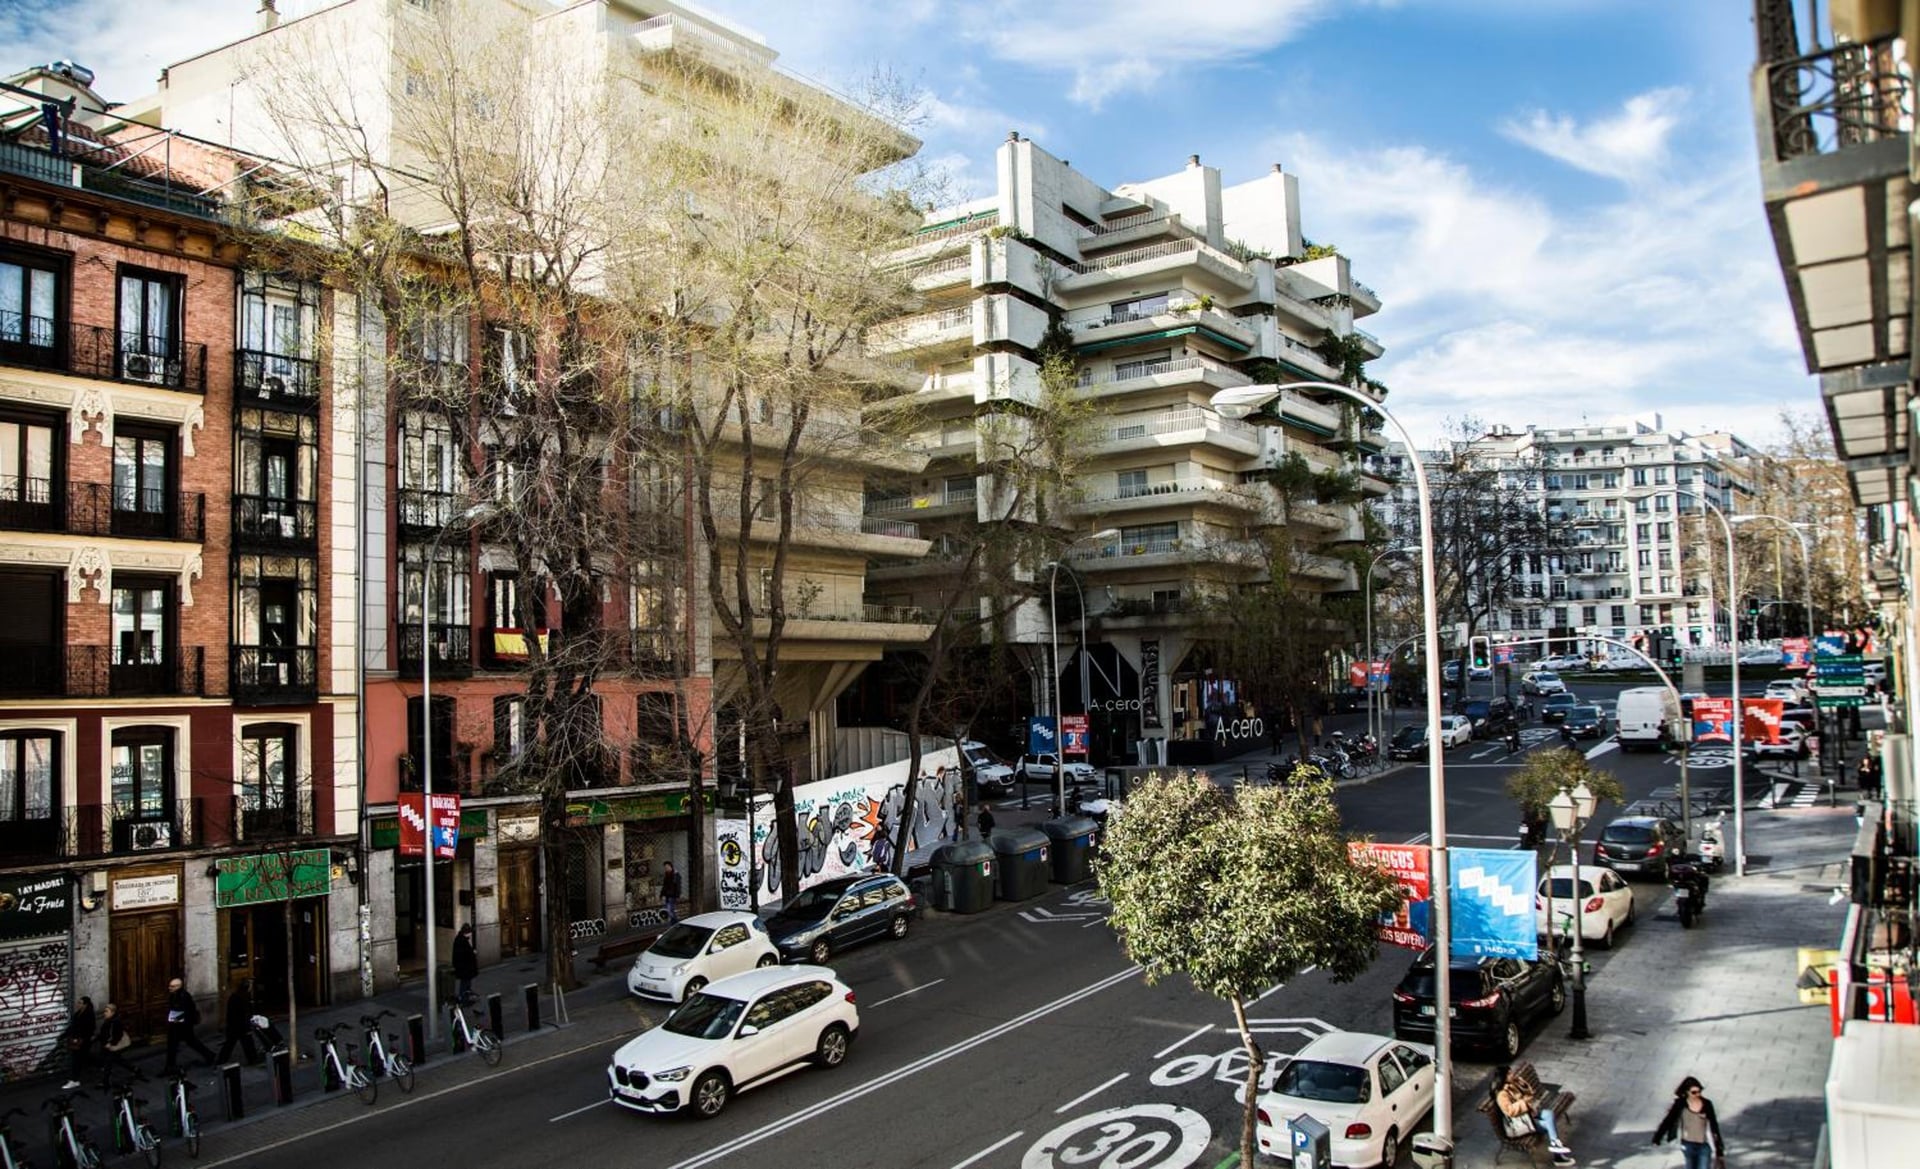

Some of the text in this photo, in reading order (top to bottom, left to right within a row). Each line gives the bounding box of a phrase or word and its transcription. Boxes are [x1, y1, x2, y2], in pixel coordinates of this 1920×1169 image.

[1090, 699, 1141, 712] A-cero
[1214, 716, 1263, 741] A-cero
[34, 877, 64, 891] MADRE!
[17, 896, 65, 914] La Fruta
[1059, 1121, 1173, 1169] 30
[1294, 1130, 1307, 1147] P
